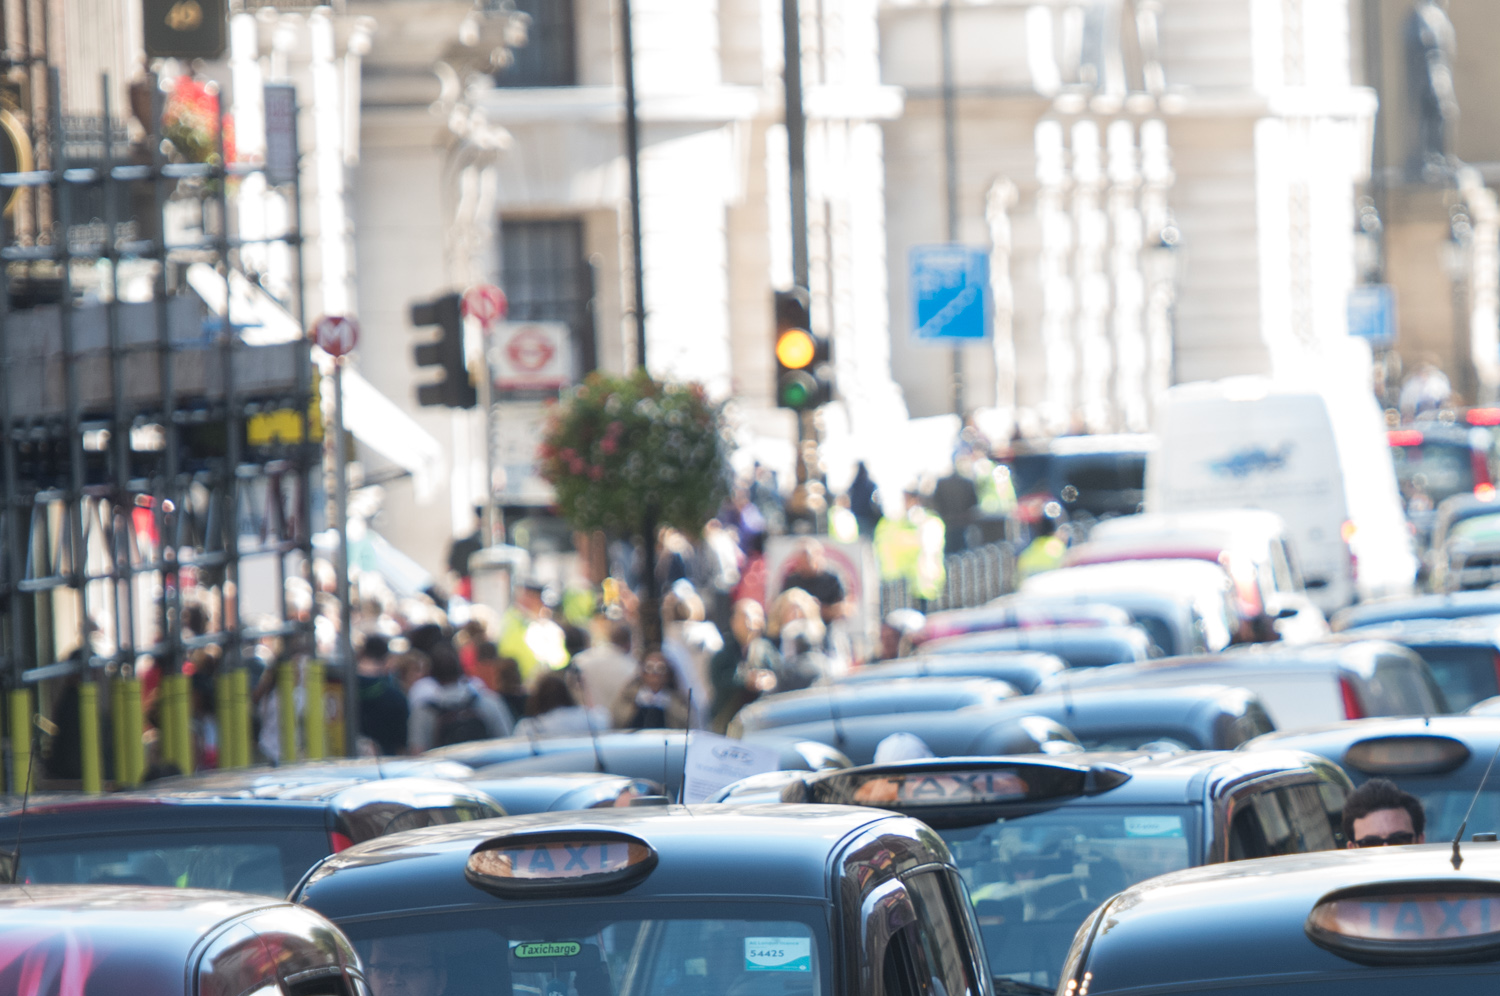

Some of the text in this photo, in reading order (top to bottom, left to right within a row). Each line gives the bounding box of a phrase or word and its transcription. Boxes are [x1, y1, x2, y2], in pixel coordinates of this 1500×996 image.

[888, 774, 994, 800] TAXI
[503, 843, 609, 872] TAXI
[1360, 896, 1491, 936] TAXI
[521, 944, 577, 956] Taxicharge
[750, 949, 785, 957] 54425
